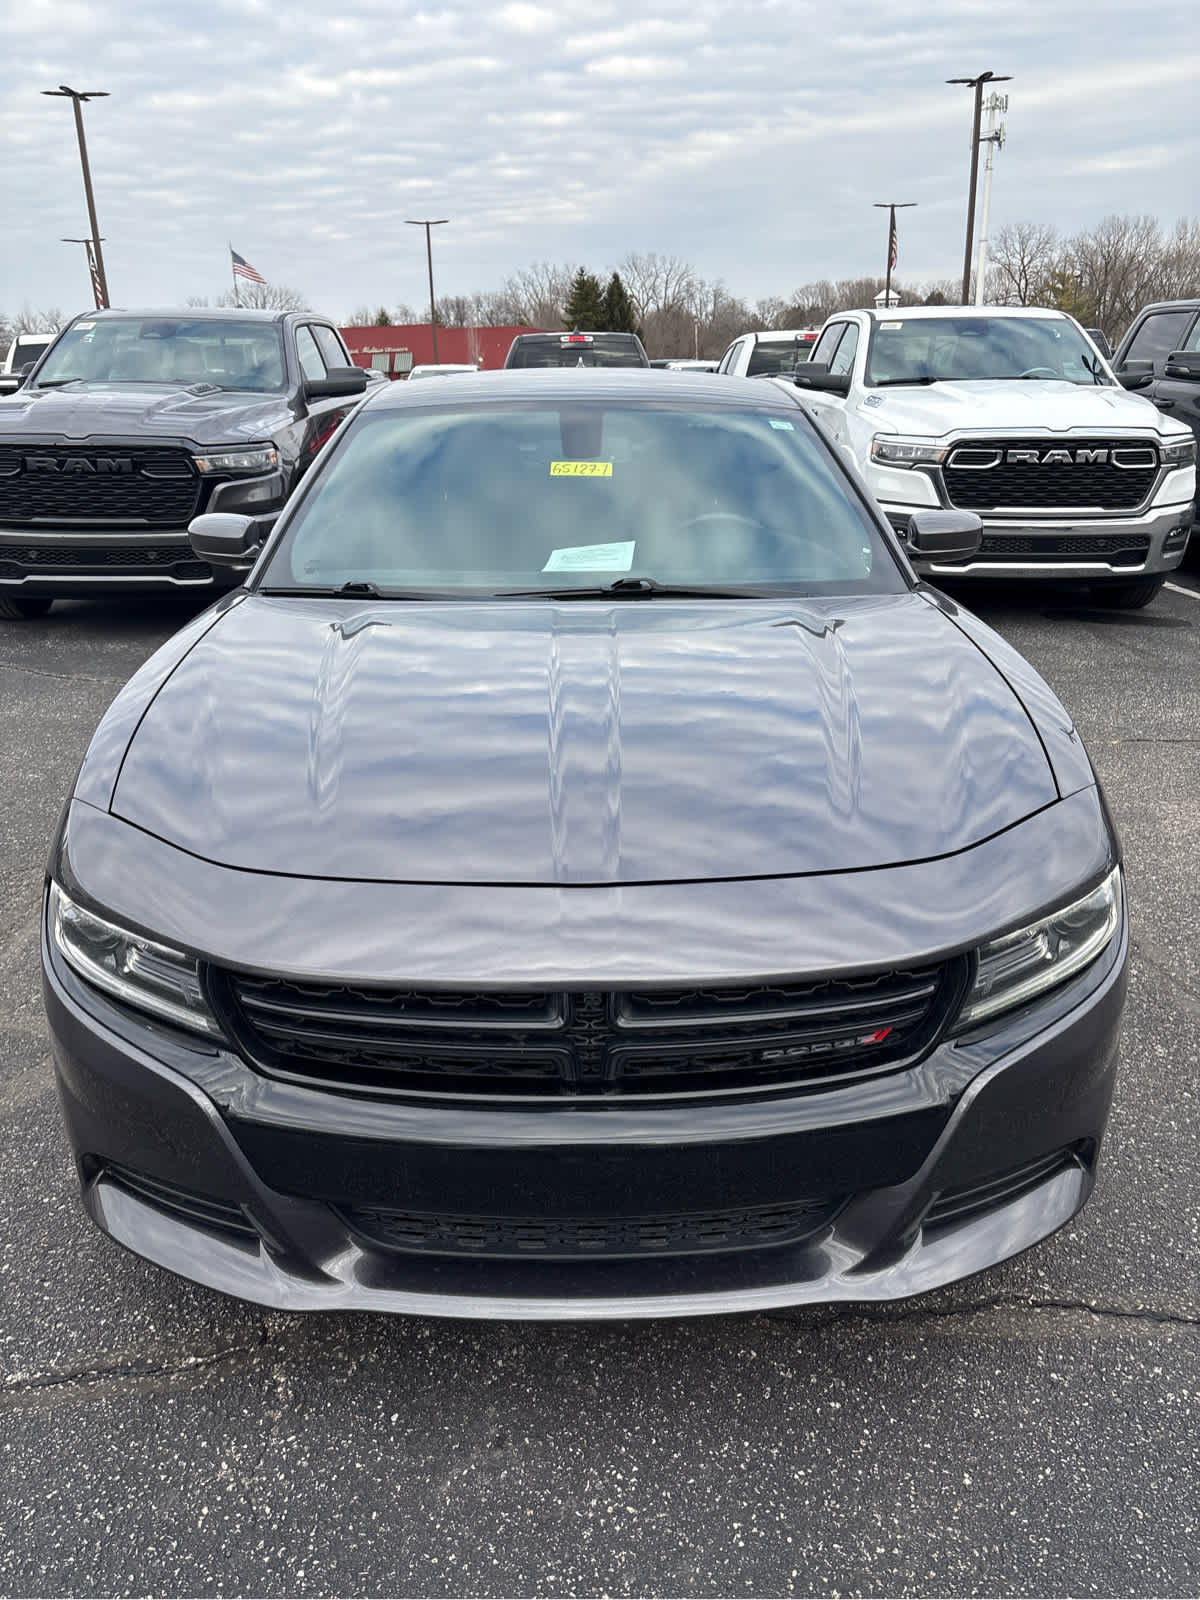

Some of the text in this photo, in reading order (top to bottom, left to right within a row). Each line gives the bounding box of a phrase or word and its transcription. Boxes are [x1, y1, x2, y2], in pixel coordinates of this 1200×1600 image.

[1006, 449, 1109, 464] RAM
[25, 457, 133, 473] RAM
[761, 1035, 874, 1060] DODGE
